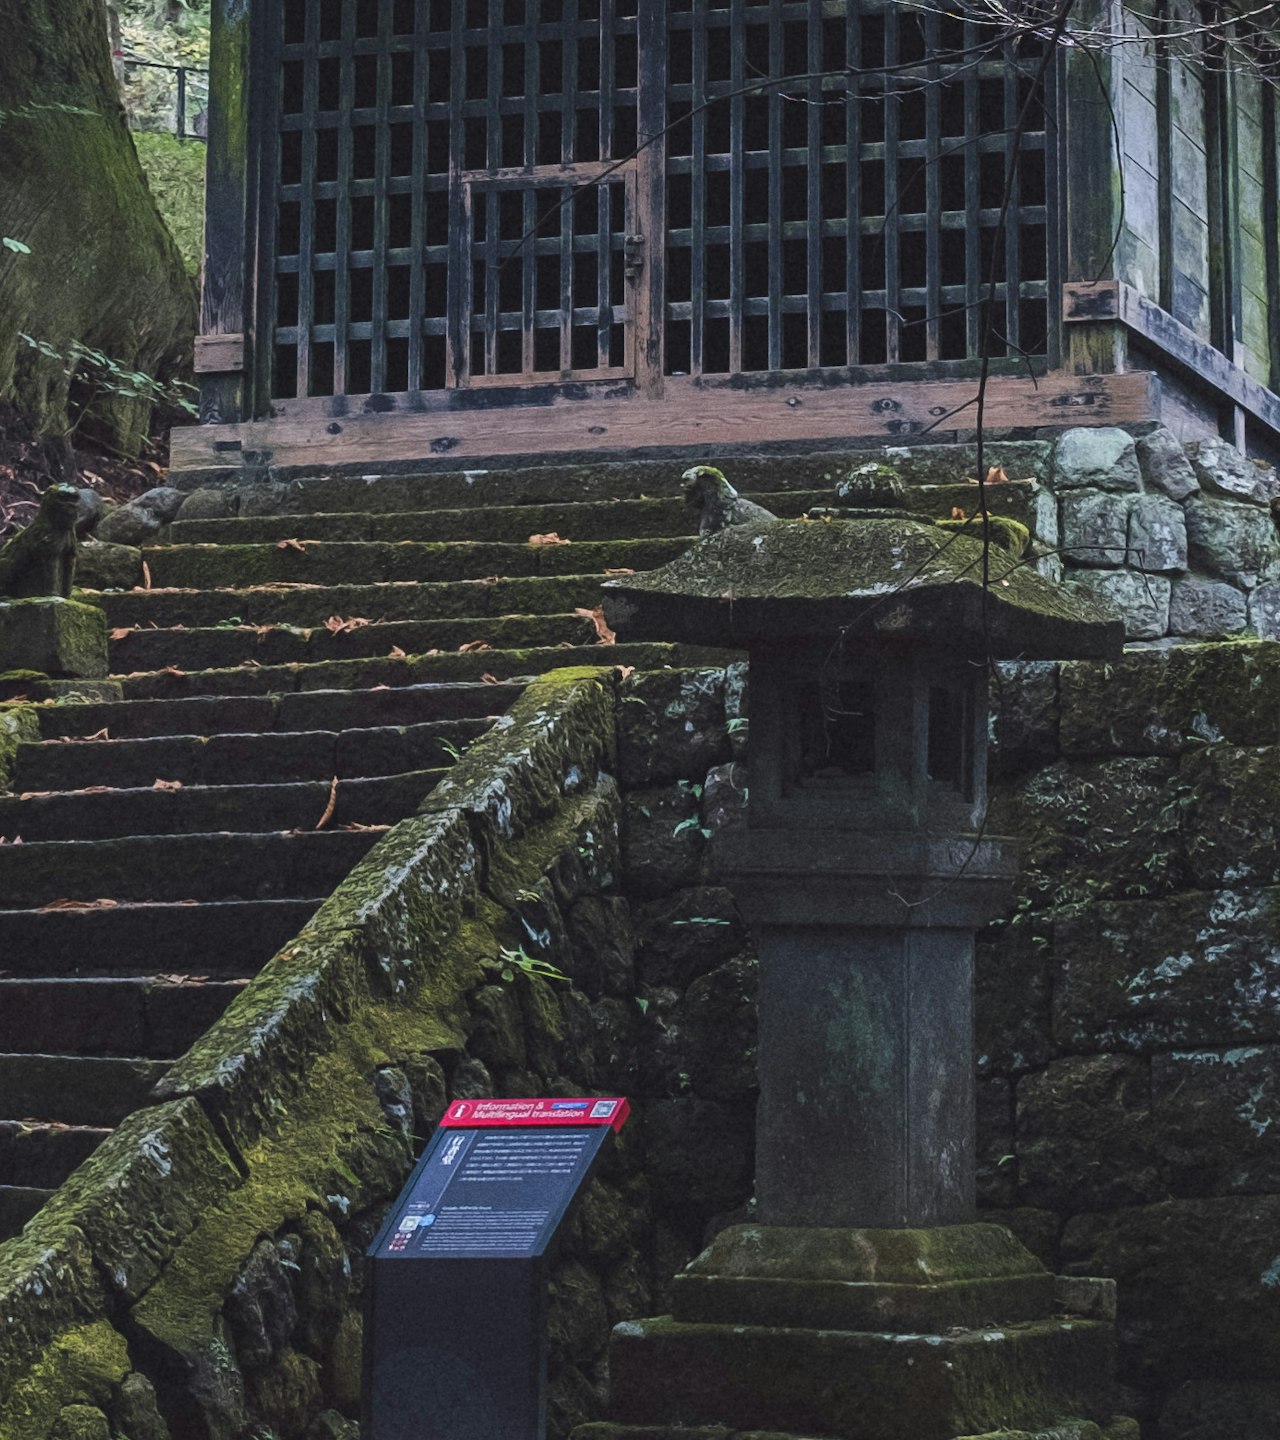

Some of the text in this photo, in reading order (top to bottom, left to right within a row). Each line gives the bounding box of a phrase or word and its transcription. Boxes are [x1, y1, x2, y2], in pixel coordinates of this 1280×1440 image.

[476, 1102, 544, 1111] Information &
[471, 1110, 585, 1120] Multilingual translation
